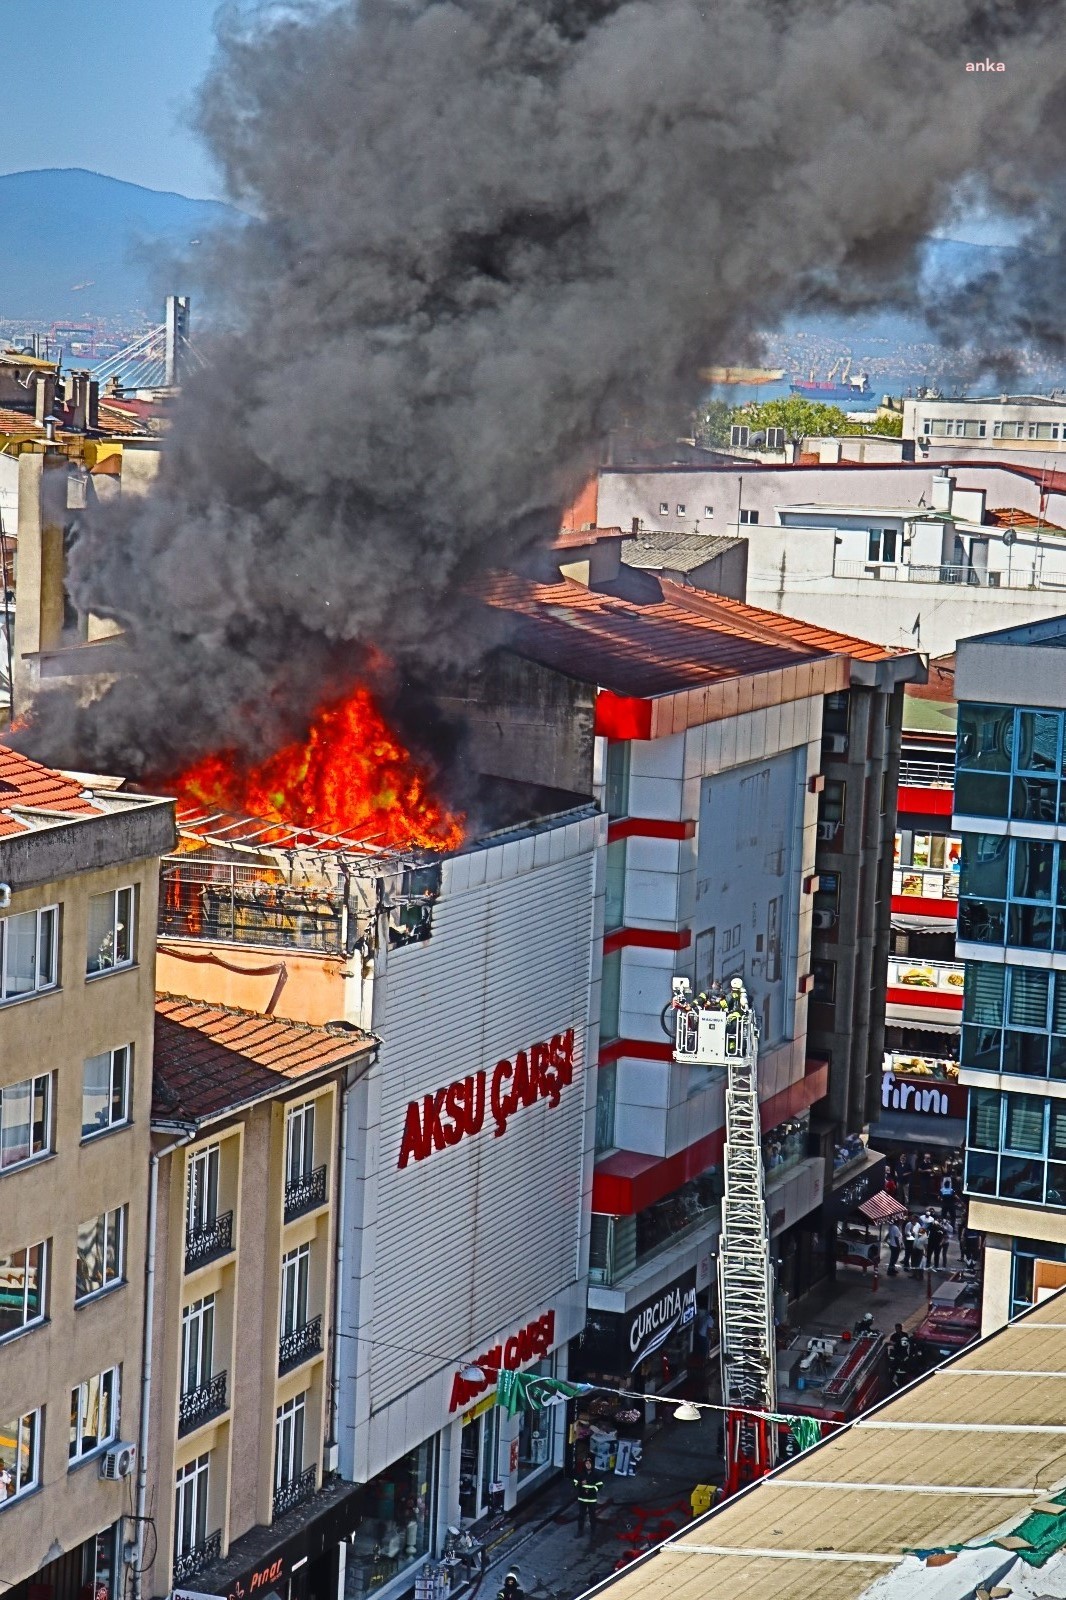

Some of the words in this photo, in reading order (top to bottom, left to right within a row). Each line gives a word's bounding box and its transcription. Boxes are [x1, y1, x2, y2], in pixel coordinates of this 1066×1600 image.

[397, 1070, 486, 1169] AKSU
[491, 1027, 574, 1138] ÇARŞI
[629, 1287, 682, 1353] CURCUNA
